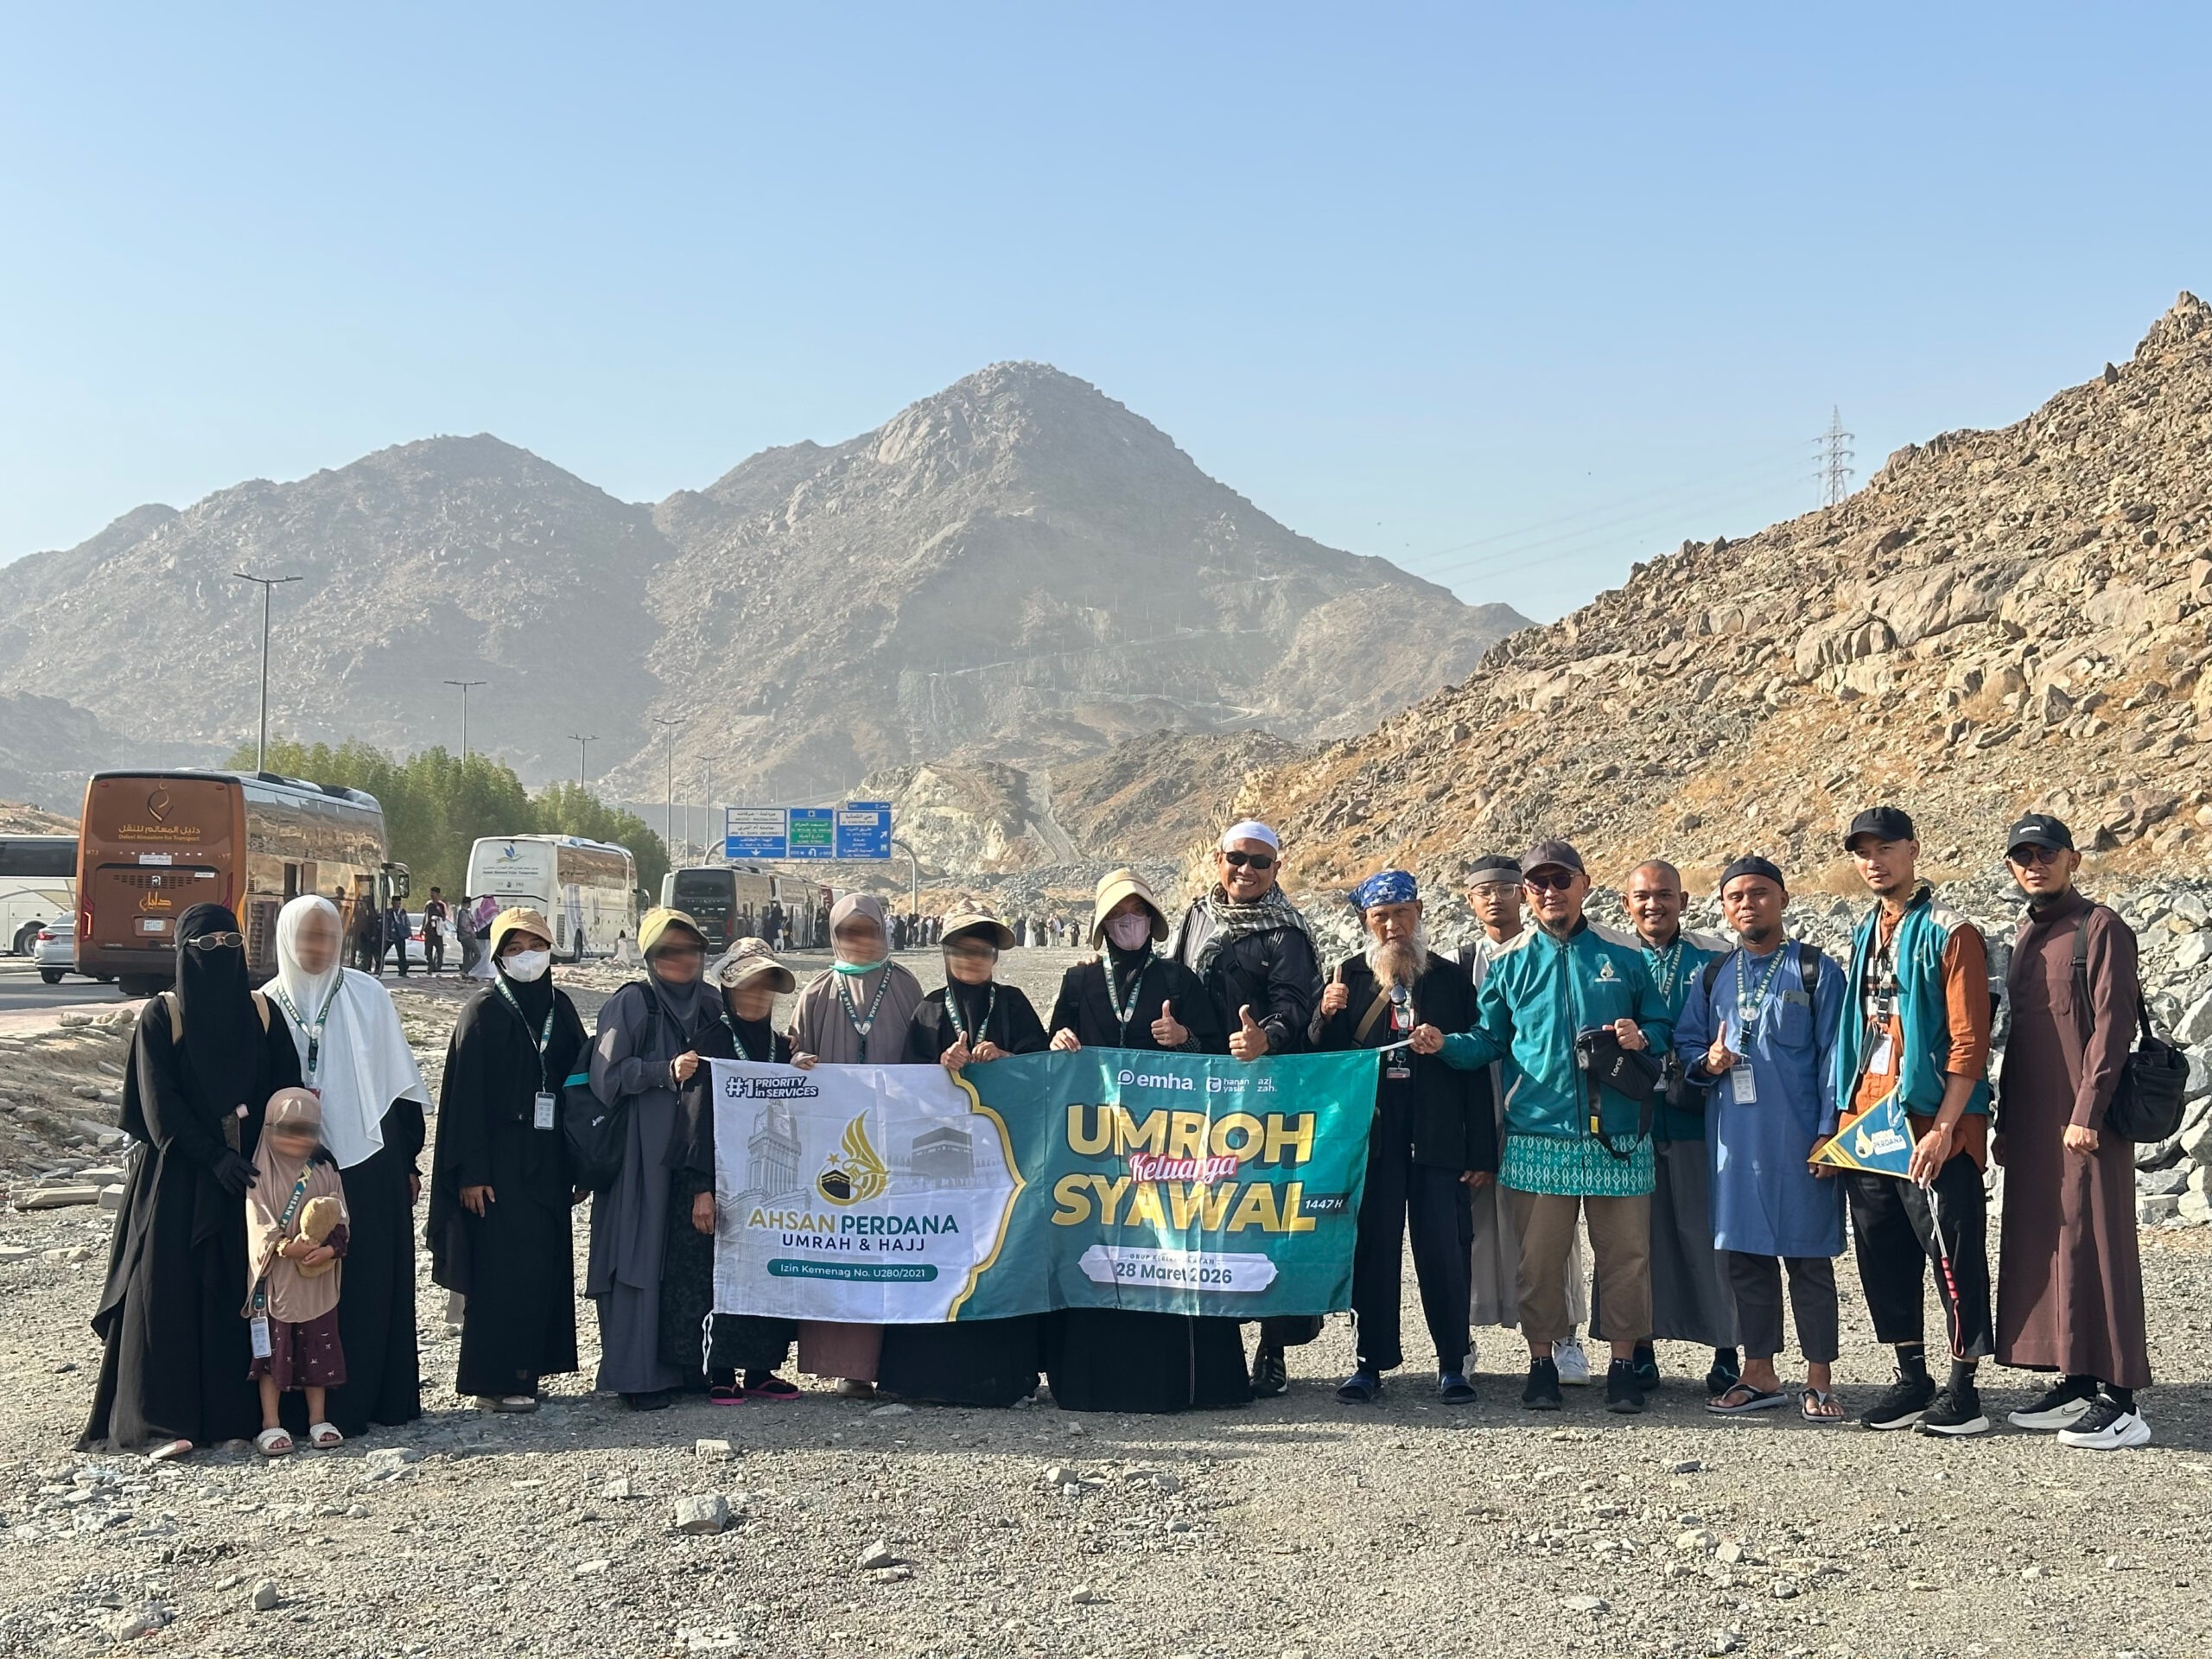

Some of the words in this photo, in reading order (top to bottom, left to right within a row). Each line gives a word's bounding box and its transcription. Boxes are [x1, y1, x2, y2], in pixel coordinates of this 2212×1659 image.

[118, 823, 144, 834] للنقل
[145, 825, 179, 835] المعالم
[180, 825, 200, 835] دليل
[1755, 979, 1770, 1003] AHSAN
[1766, 949, 1785, 978] PERDANA
[1611, 1056, 1624, 1077] torch
[727, 1077, 754, 1097] #1
[755, 1077, 805, 1088] PRIORITY
[755, 1088, 765, 1097] in
[766, 1087, 818, 1098] SERVICES
[1067, 1105, 1315, 1164] UMROH
[1873, 1136, 1904, 1148] PERDANA
[1128, 1152, 1237, 1185] Keluarga
[1051, 1173, 1317, 1232] SYAWAL
[748, 1208, 836, 1234] AHSAN
[841, 1214, 960, 1236] PERDANA
[782, 1233, 851, 1250] UMRAH
[858, 1237, 871, 1251] &
[879, 1238, 925, 1252] HAJJ
[780, 1263, 798, 1273] Izin
[802, 1265, 851, 1279] Kemenag
[854, 1268, 871, 1278] No.
[874, 1268, 925, 1279] U280/2021
[1116, 1263, 1137, 1277] 28
[1141, 1264, 1187, 1282] Maret
[1190, 1268, 1233, 1284] 2026
